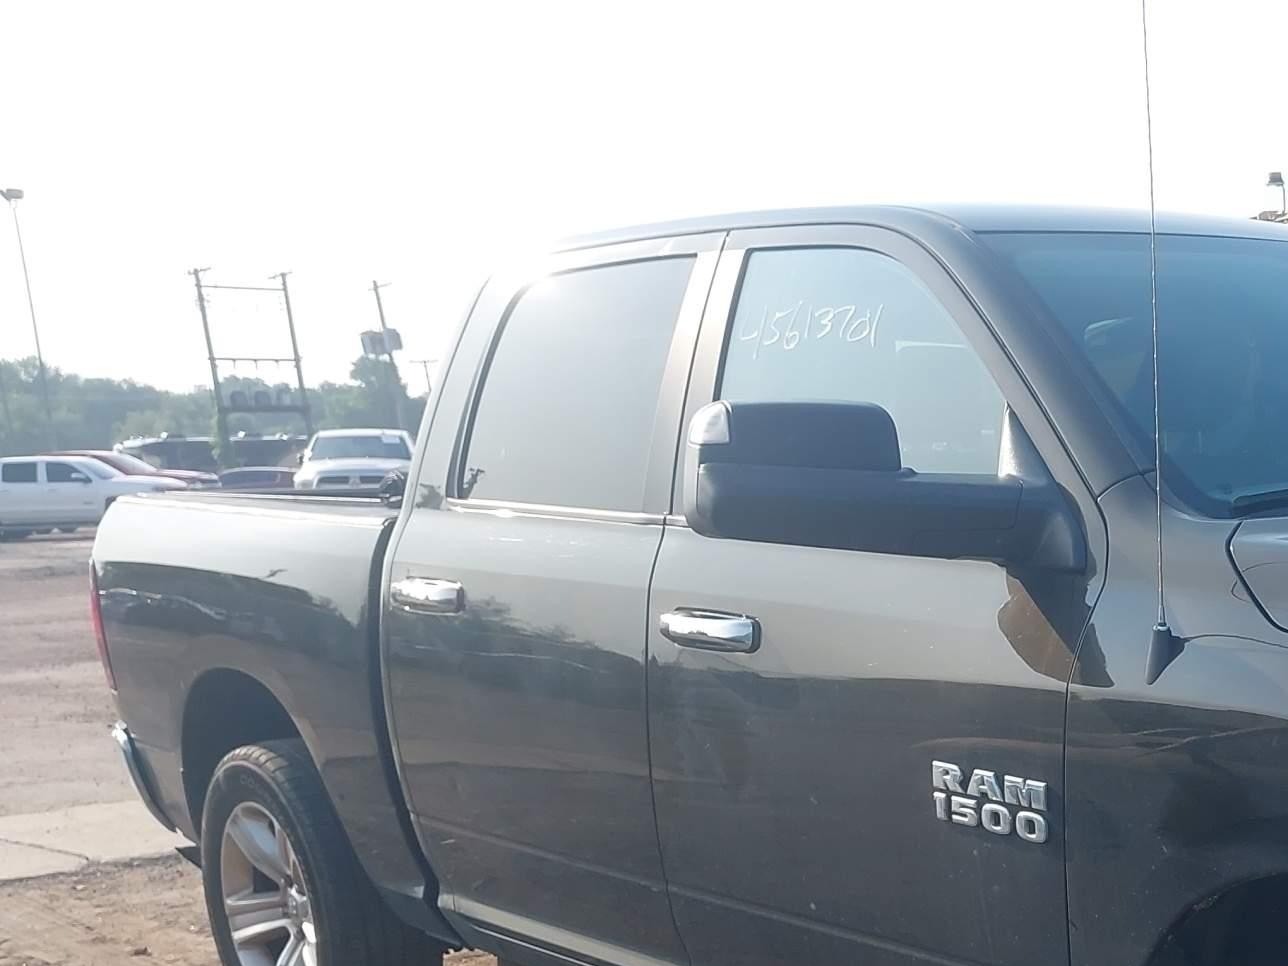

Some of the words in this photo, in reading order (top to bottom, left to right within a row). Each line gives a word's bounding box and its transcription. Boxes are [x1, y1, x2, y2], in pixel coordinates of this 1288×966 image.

[740, 300, 884, 360] 45613701
[932, 760, 1048, 811] RAM
[932, 791, 1048, 844] 1500
